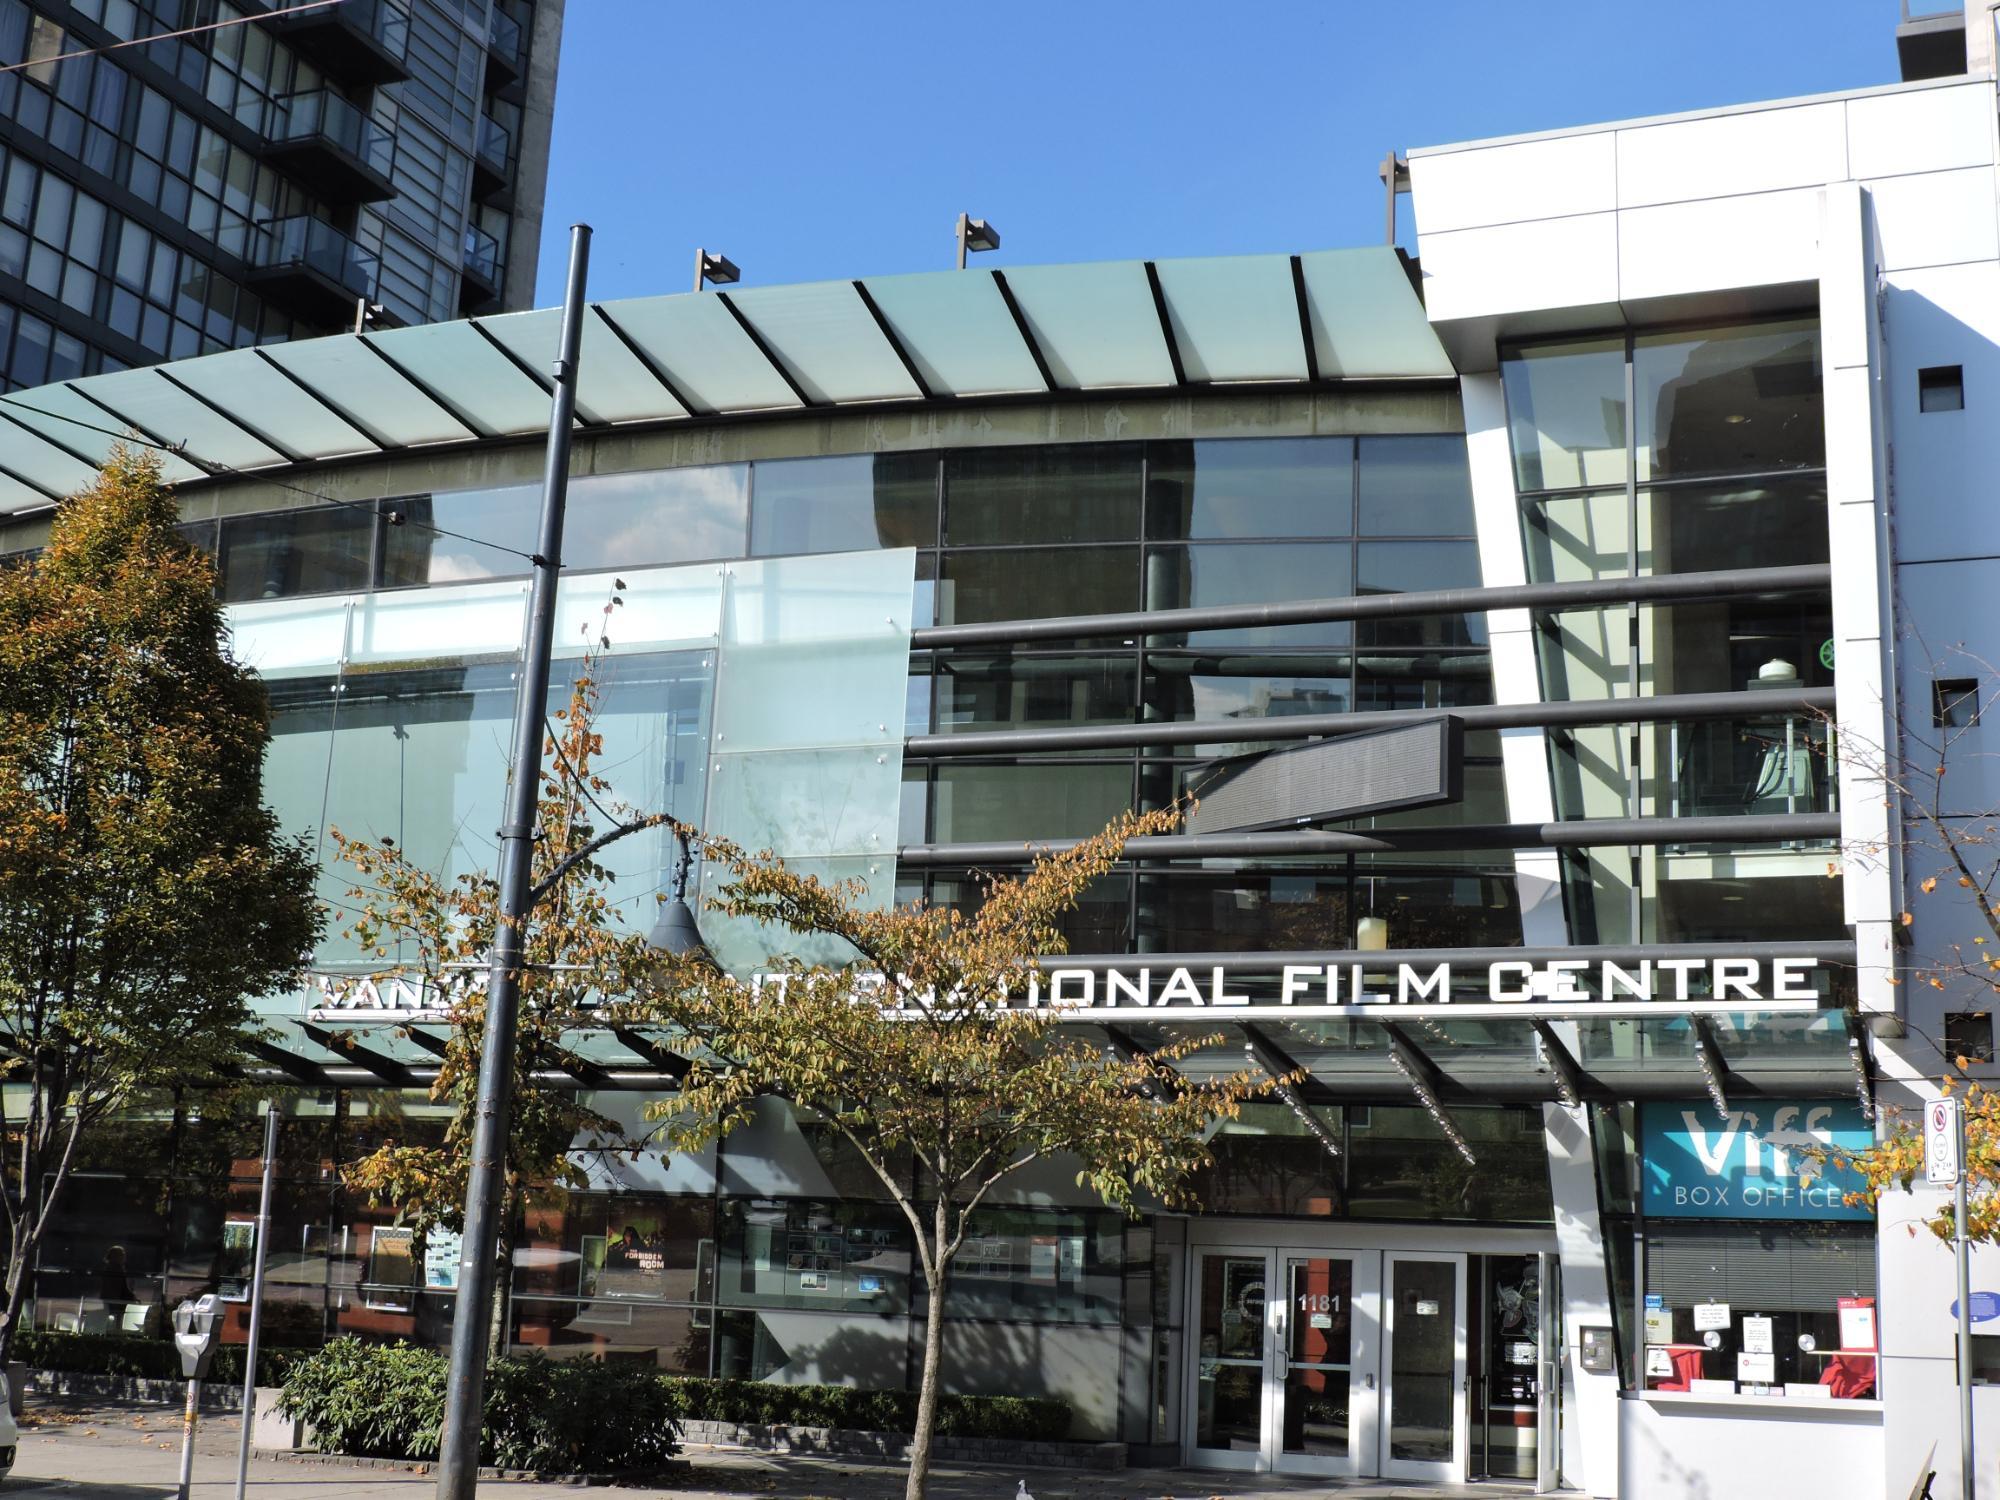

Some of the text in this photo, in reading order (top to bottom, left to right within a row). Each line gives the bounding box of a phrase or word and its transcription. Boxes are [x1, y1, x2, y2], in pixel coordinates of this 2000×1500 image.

[1281, 963, 1450, 1005] FILM
[1489, 957, 1818, 1002] CENTRE
[1675, 1186, 1841, 1208] BOX OFFICE
[624, 1252, 662, 1260] FORBIDDEN
[640, 1260, 664, 1269] ROOM
[1299, 1294, 1340, 1312] 1181
